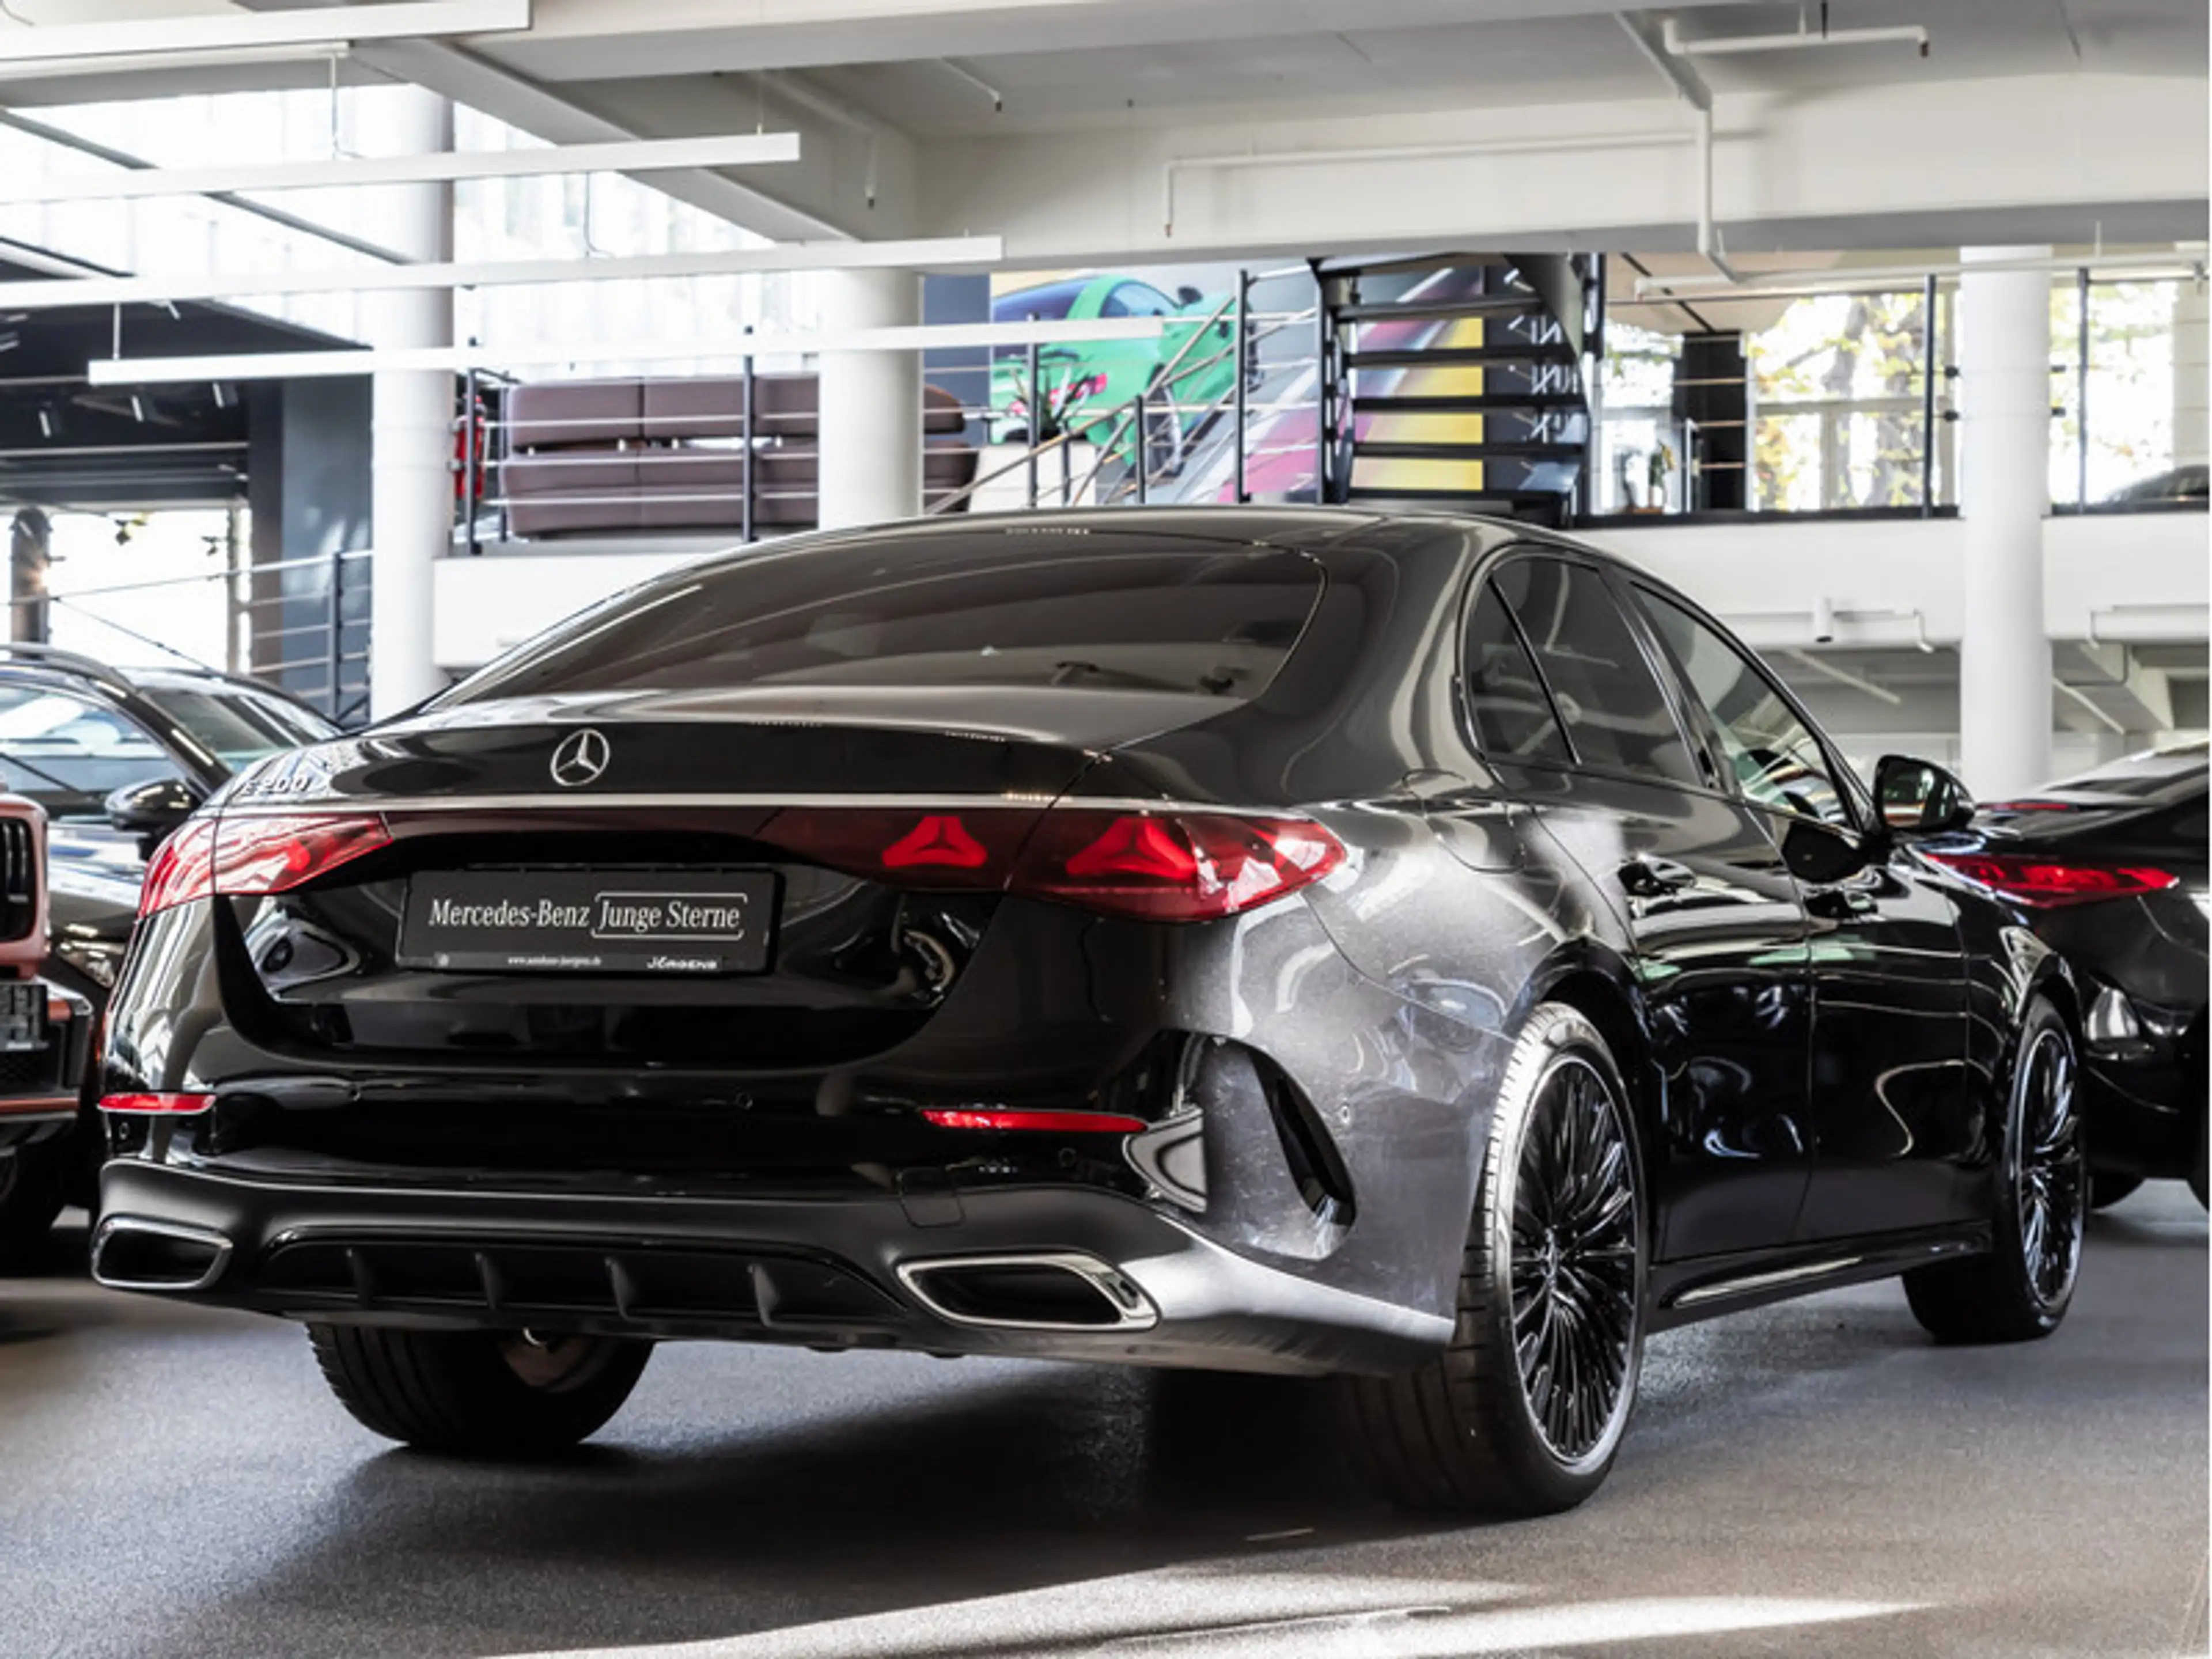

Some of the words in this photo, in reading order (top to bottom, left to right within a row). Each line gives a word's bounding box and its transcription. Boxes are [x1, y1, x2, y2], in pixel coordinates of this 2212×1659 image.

[257, 776, 310, 793] 200
[428, 898, 590, 927] Mercedes-Benz
[598, 899, 662, 932] Junge
[666, 900, 740, 928] Sterne
